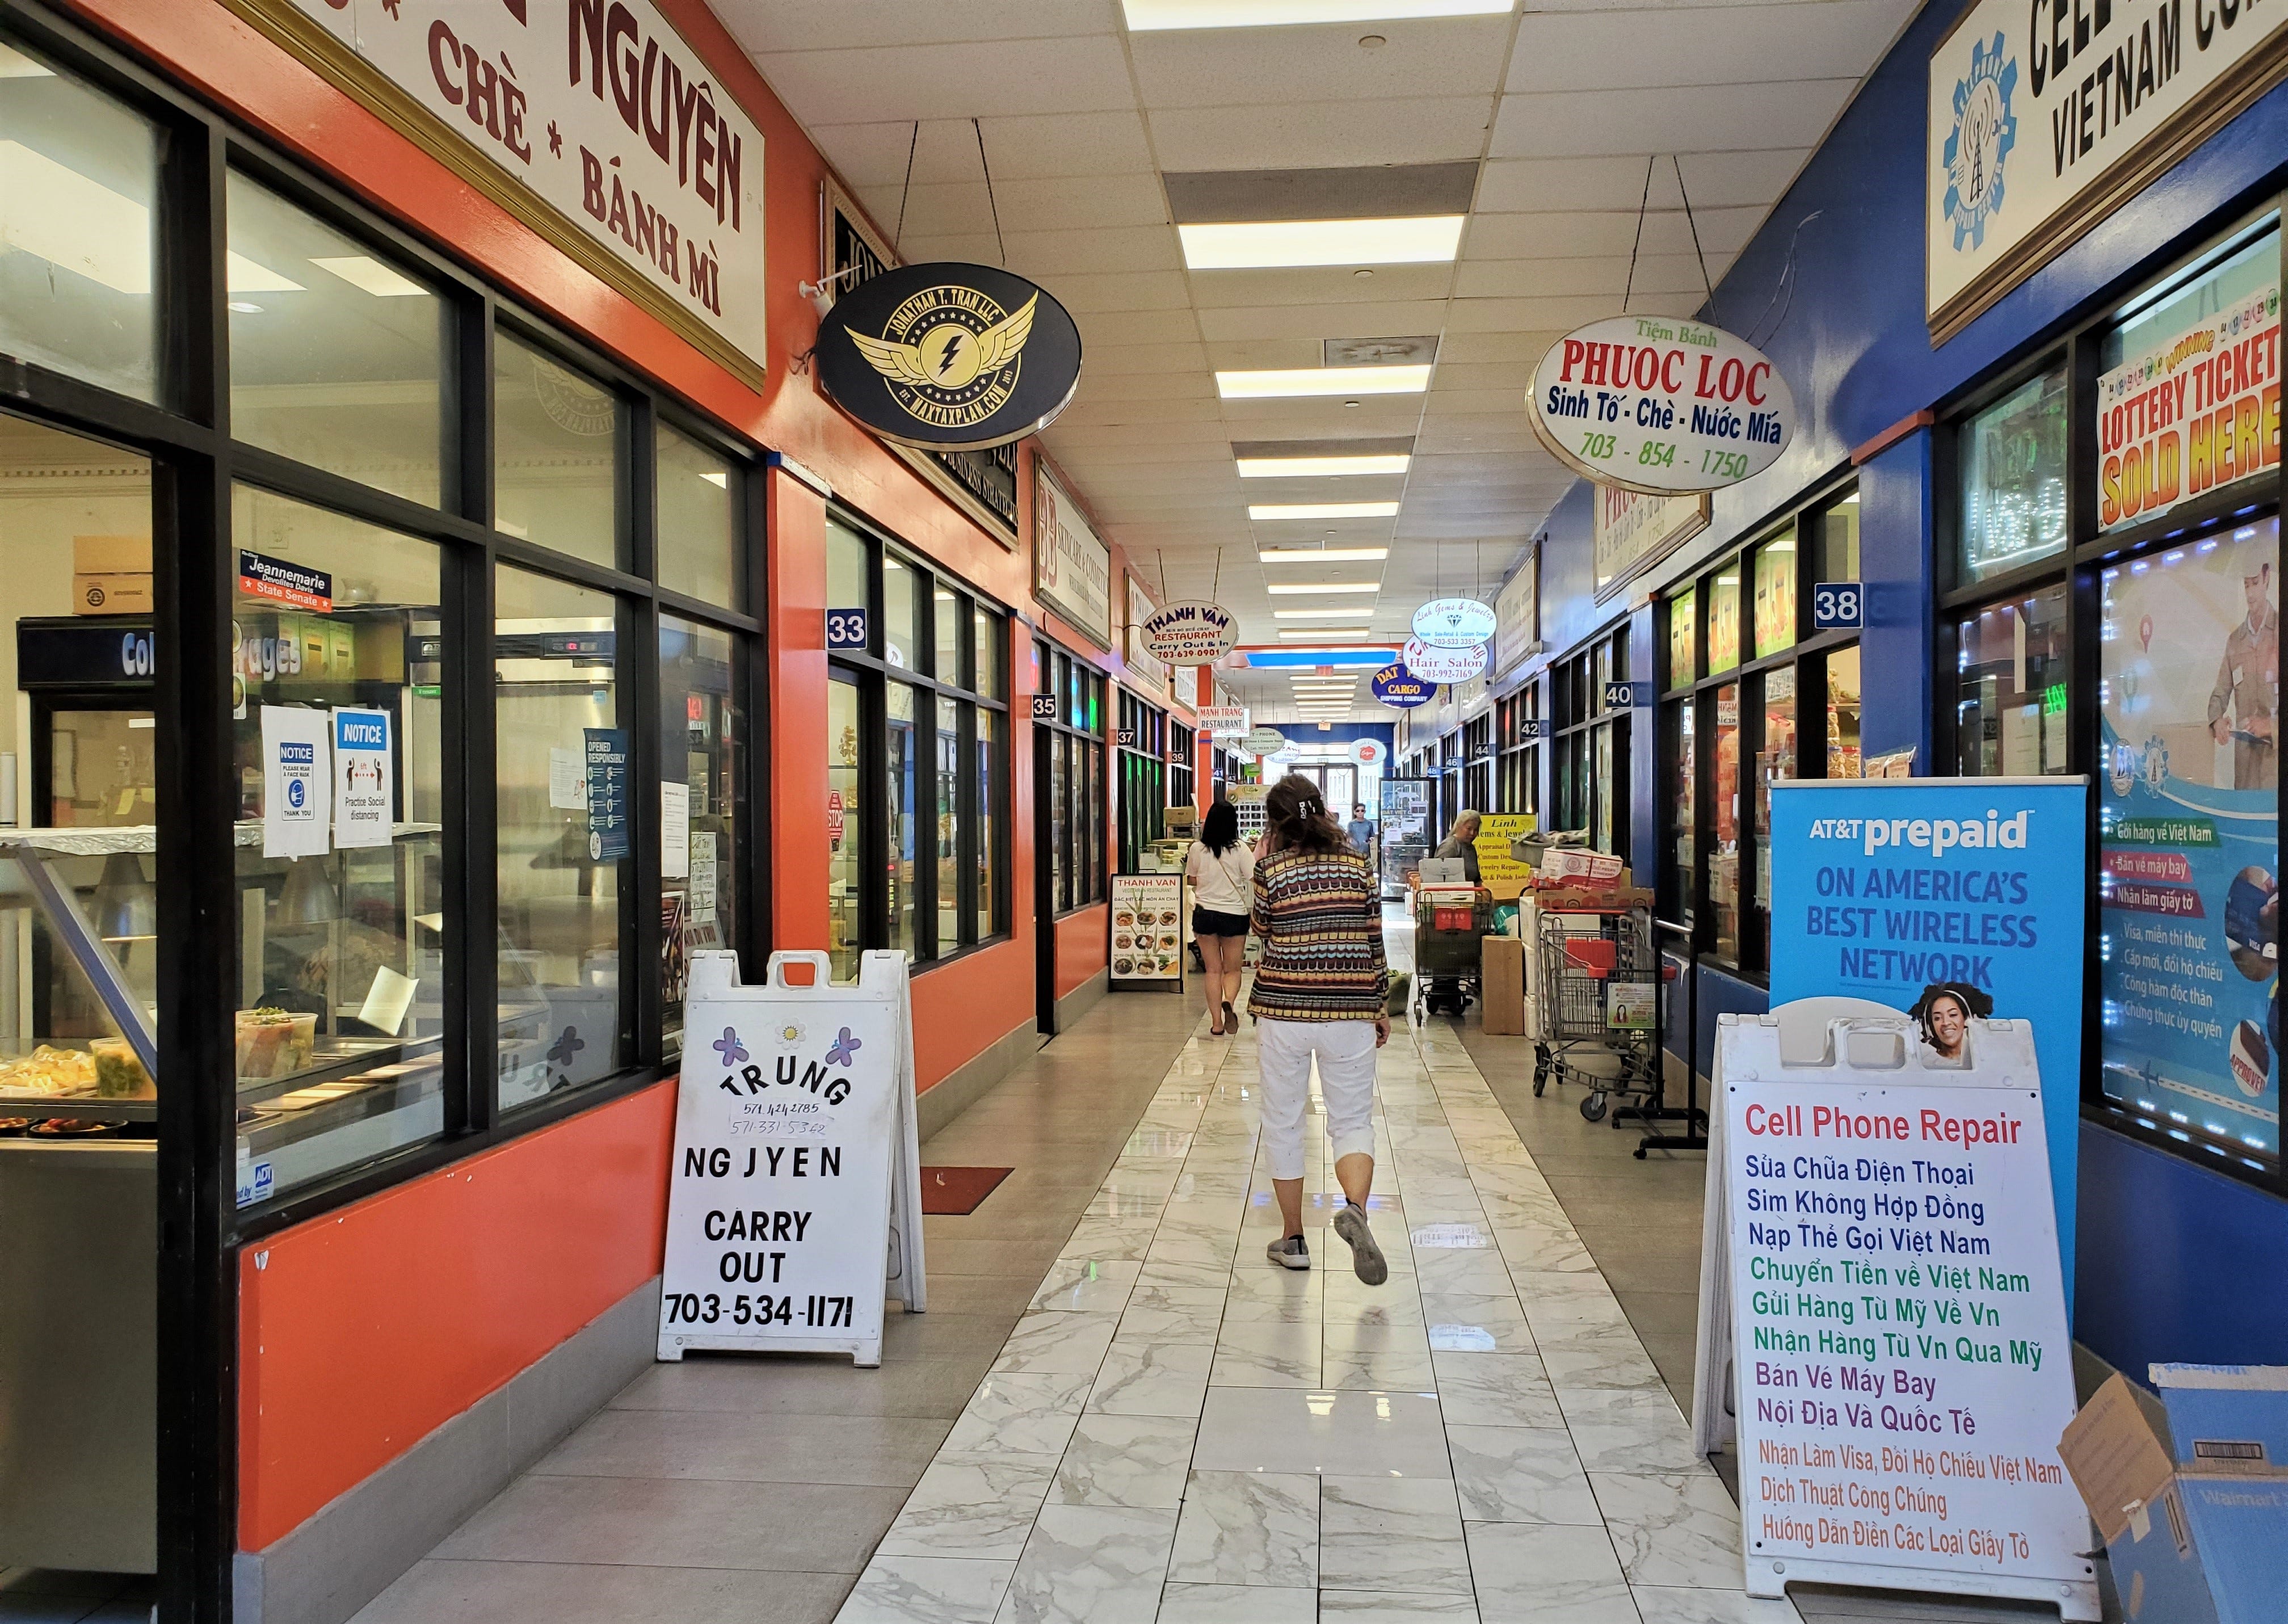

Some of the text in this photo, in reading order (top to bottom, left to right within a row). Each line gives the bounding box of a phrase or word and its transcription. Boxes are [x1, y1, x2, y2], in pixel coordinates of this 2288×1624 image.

[2052, 2, 2180, 179] VIETNAM
[568, 0, 741, 232] NGUYÊN
[428, 20, 721, 317] CHÈ BÁNH MÌ
[889, 289, 999, 336] JONATHAN T. TRAN LLC
[1636, 319, 1718, 348] Tiệm Bánh
[2166, 330, 2215, 374] WINNING
[1560, 339, 1770, 406] PHUOC LOC
[899, 389, 911, 402] EST.
[910, 386, 1008, 425] MAXTAXPLAN.COM
[1547, 386, 1782, 444] Sinh Tố Chè Nước Mía
[2102, 371, 2188, 455] LOTTERY
[1579, 432, 1748, 479] 703 854 1750
[2102, 382, 2280, 526] SOLD HERE
[1058, 521, 1082, 569] SKINCARE
[249, 558, 325, 590] Jeannemarie
[295, 583, 314, 594] Davis
[257, 582, 317, 606] State Senate
[1816, 591, 1858, 620] 38
[1145, 607, 1229, 634] THANH VÂN
[1417, 606, 1432, 622] Linh
[1435, 603, 1455, 616] Gems
[1458, 601, 1465, 610] &
[828, 616, 865, 642] 33
[1155, 631, 1222, 642] RESTAURANT
[1158, 649, 1219, 659] 703-639-0901
[1410, 658, 1483, 667] Hair Salon
[1376, 666, 1398, 685] DAT
[1387, 684, 1420, 695] CARGO
[1034, 699, 1055, 714] 35
[1606, 686, 1630, 704] 40
[1200, 708, 1243, 718] MẠNH TRANG
[1201, 720, 1242, 729] RESTAURANT
[344, 723, 381, 743] NOTICE
[1118, 731, 1134, 743] 37
[1521, 723, 1538, 735] 42
[280, 747, 313, 759] NOTICE
[588, 742, 611, 752] OPENED
[588, 753, 625, 764] RESPONSIBLY
[1172, 753, 1184, 762] 39
[1476, 746, 1488, 755] 44
[346, 797, 385, 806] Practice Social
[351, 810, 379, 822] distancing
[828, 810, 843, 827] STOP
[1810, 809, 2028, 857] AT&T prepaid
[2134, 823, 2155, 844] hàng
[2189, 825, 2212, 842] Nam
[1816, 866, 2029, 904] ON AMERICA'S
[1807, 906, 2037, 949] BEST WIRELESS
[2249, 939, 2260, 952] VISA
[1840, 947, 1994, 988] NETWORK
[720, 1055, 851, 1105] TRUNG
[1746, 1104, 2021, 1150] Cell Phone Repair
[256, 1167, 272, 1181] ADT
[1855, 1159, 1904, 1186] Điện
[1912, 1160, 1974, 1189] Thoại
[1747, 1188, 1984, 1226] Sim Không Hợp Đồng
[704, 1210, 813, 1242] CARRY
[1749, 1222, 1990, 1256] Nạp Thẻ Gọi Việt Nam
[720, 1251, 786, 1283] OUT
[1751, 1256, 2030, 1293] Chuyển Tiền về Việt Nam
[1797, 1293, 1854, 1325] Hàng
[1895, 1298, 1927, 1329] Mỹ
[1933, 1298, 1962, 1325] Về
[1969, 1302, 2000, 1327] Vn
[1756, 1362, 1936, 1402] Bán Vé Máy Bay
